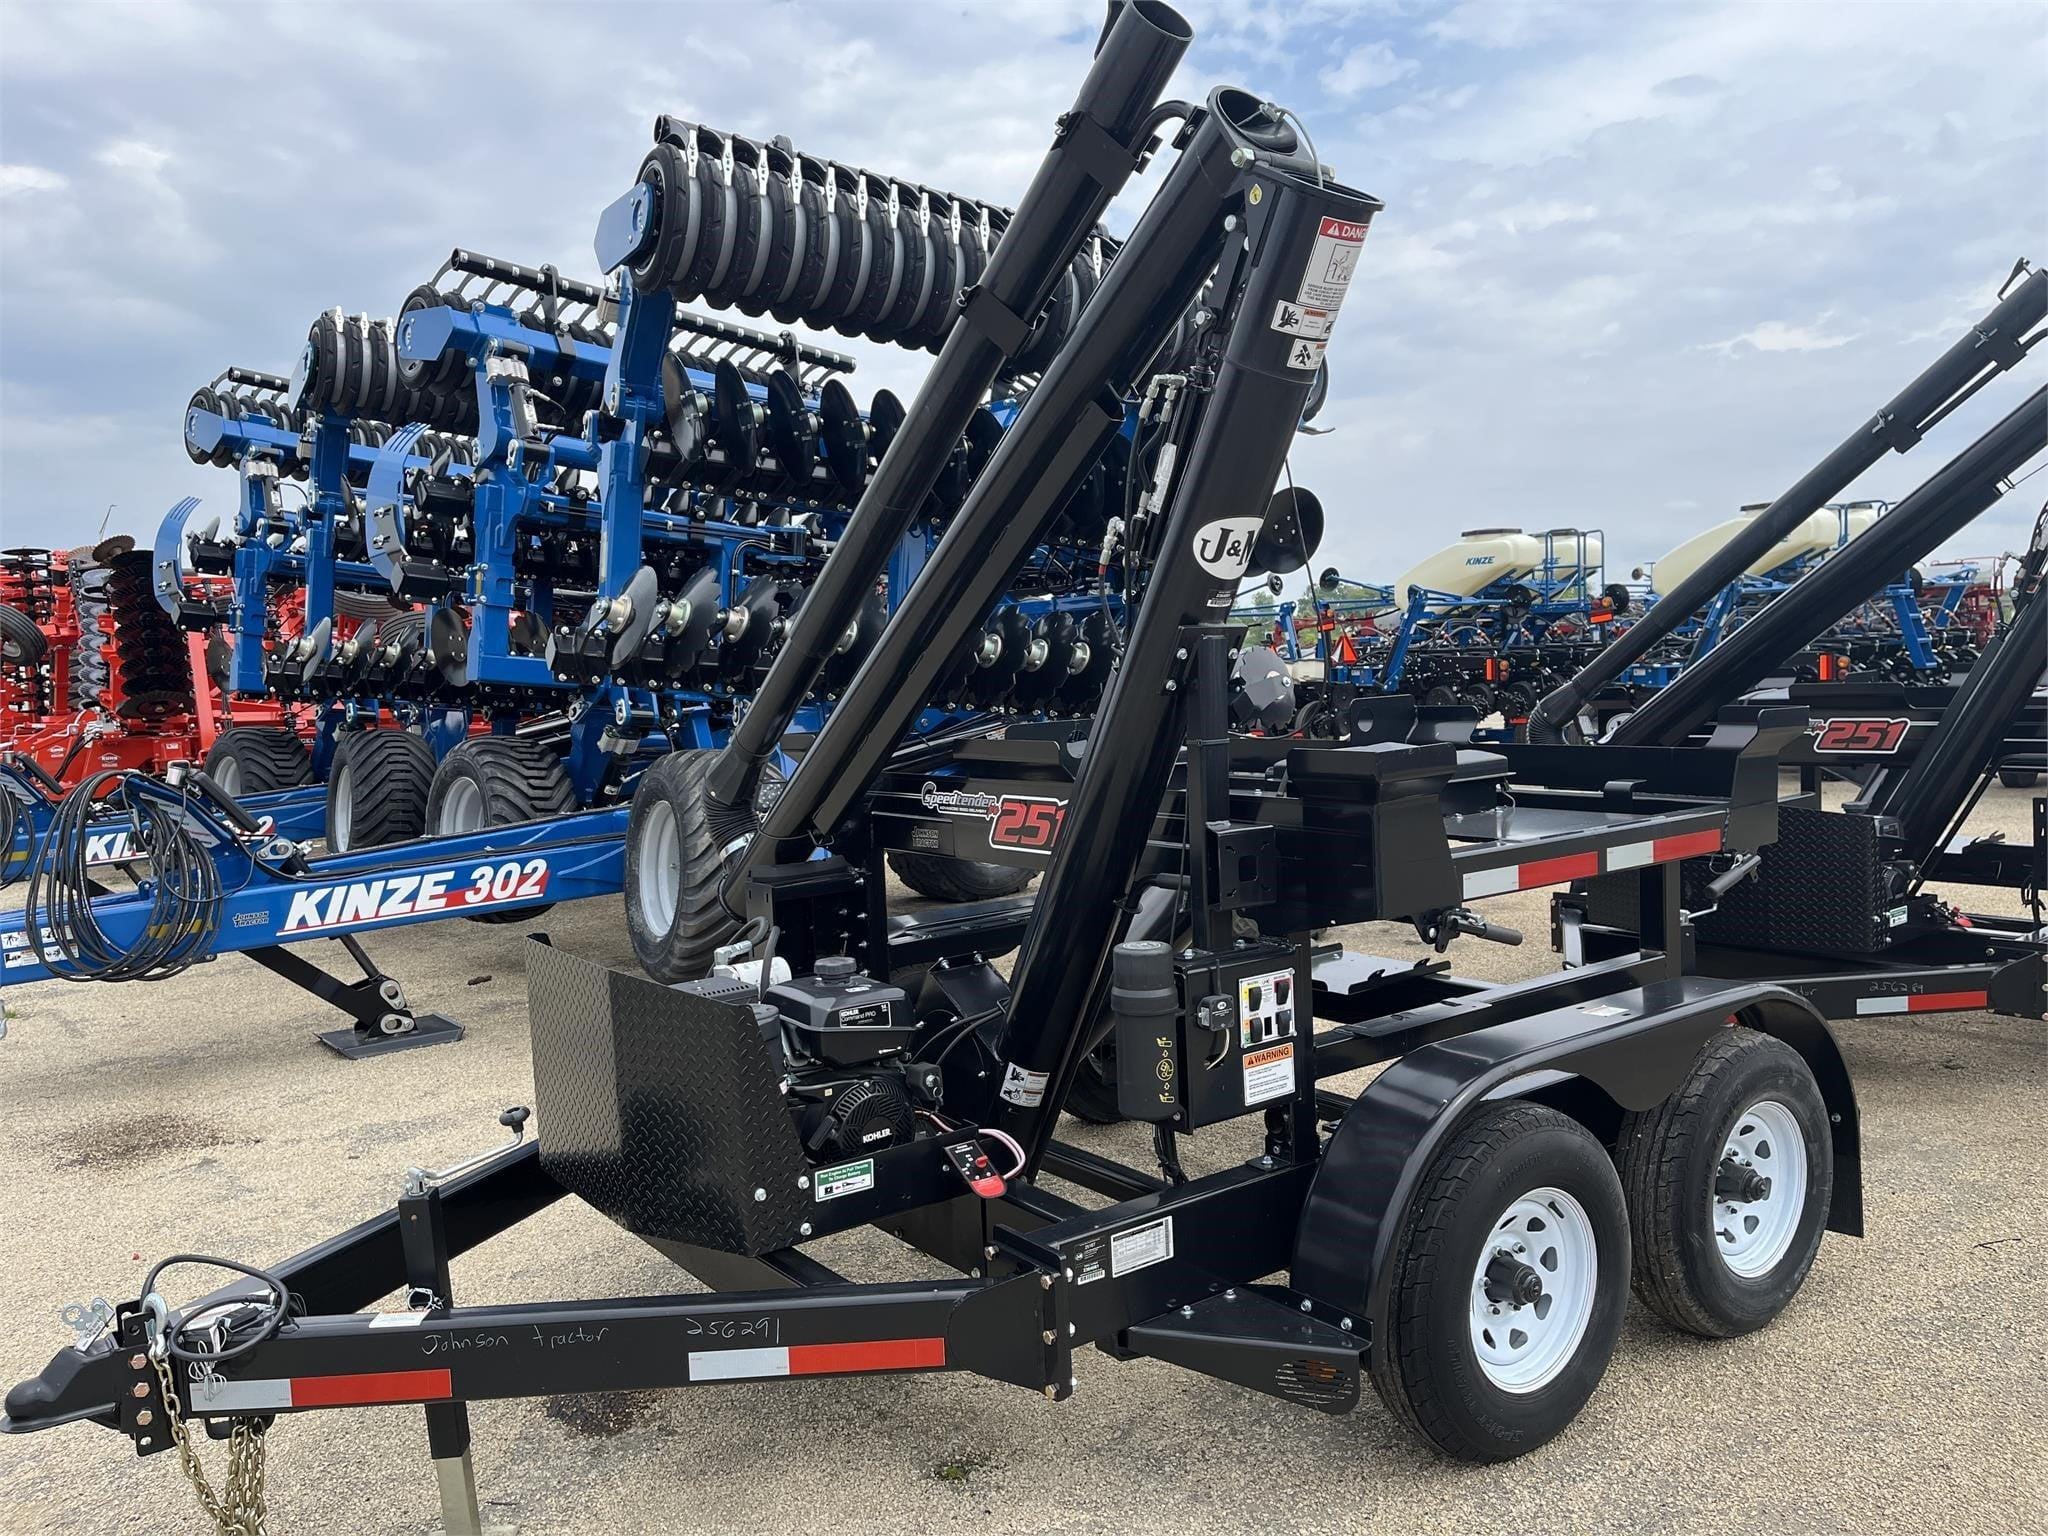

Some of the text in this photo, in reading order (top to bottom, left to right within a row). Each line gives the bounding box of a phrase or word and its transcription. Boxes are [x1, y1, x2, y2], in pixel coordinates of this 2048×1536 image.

[1342, 224, 1369, 240] DANG
[1466, 556, 1495, 566] KINZE
[1819, 722, 1906, 750] 251
[284, 858, 548, 930] KINZE 302
[234, 912, 269, 921] JOHNSON
[234, 918, 269, 926] TRACTOR
[1254, 1046, 1290, 1063] WARNING
[862, 1127, 891, 1143] KOHLER
[685, 1317, 780, 1344] 256291
[421, 1325, 610, 1355] Johnson tractor
